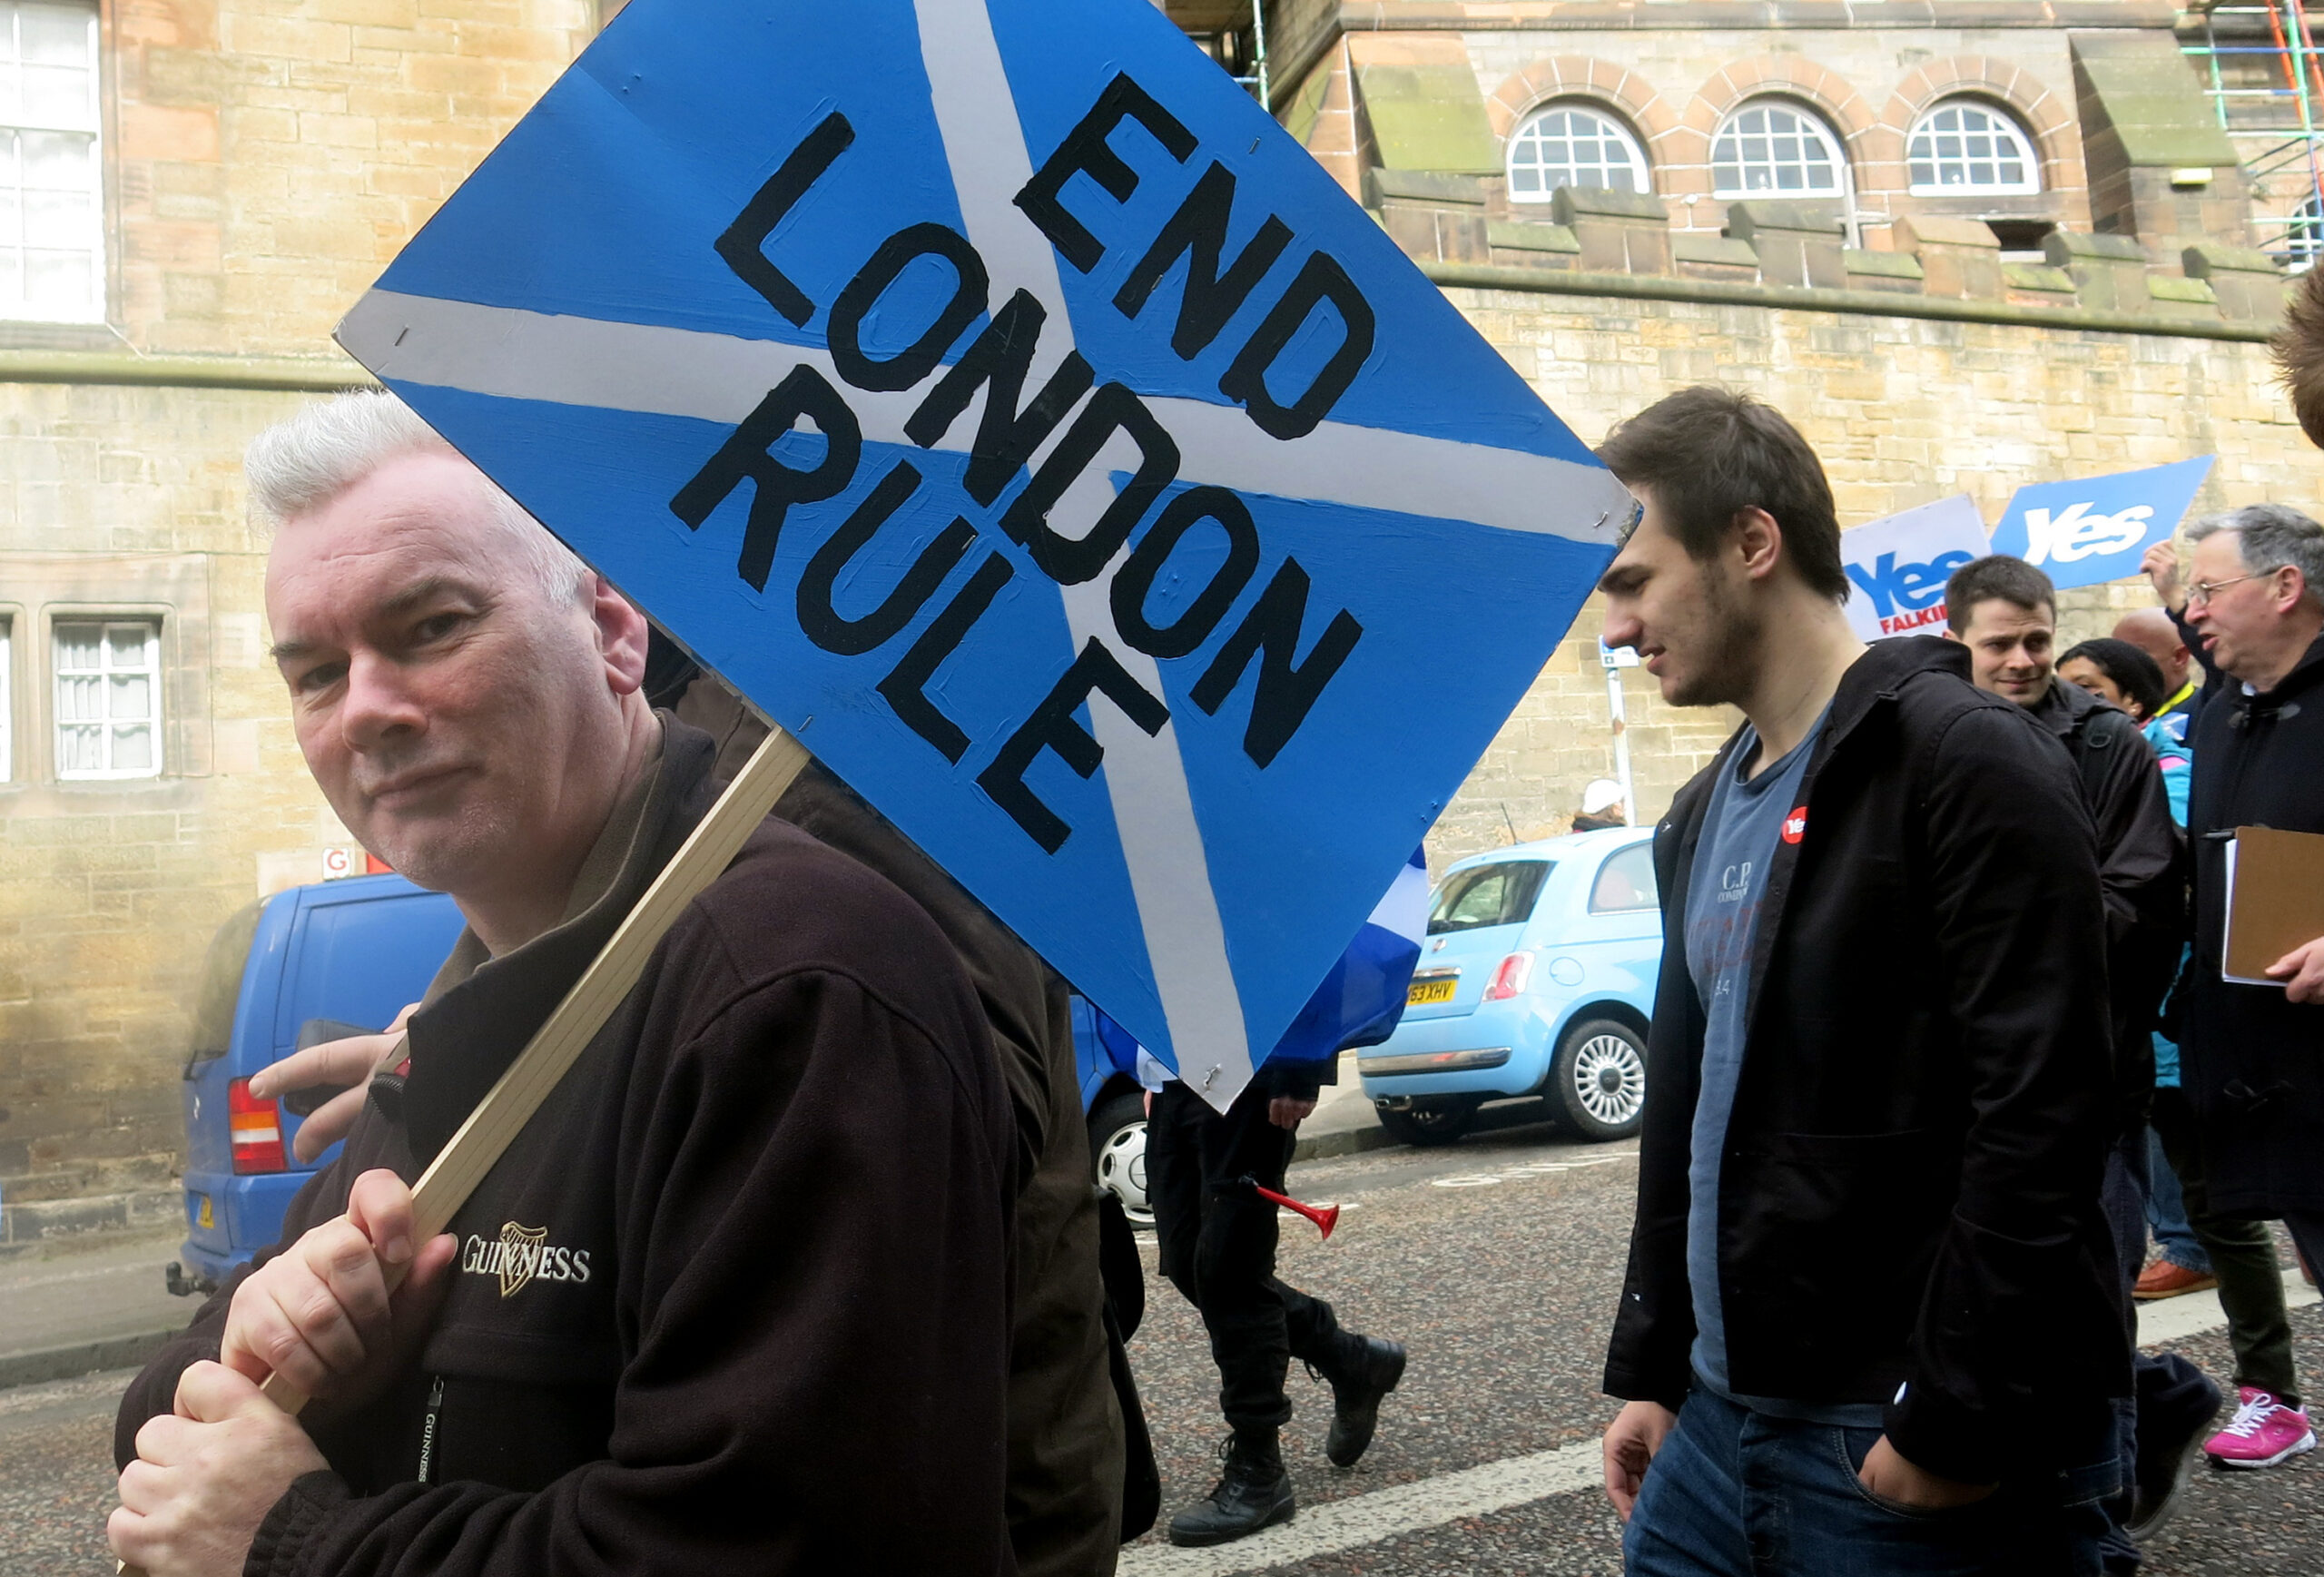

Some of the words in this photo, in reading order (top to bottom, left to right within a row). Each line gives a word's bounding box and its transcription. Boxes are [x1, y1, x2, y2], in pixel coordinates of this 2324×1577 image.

[1011, 71, 1375, 441] END
[714, 111, 1364, 770] LONDON
[2023, 501, 2154, 566] Yes
[668, 363, 1171, 856] RULE
[1787, 817, 1806, 834] Ye
[327, 850, 347, 871] G
[1425, 981, 1452, 1000] XHV
[418, 1413, 436, 1483] GUINNESS
